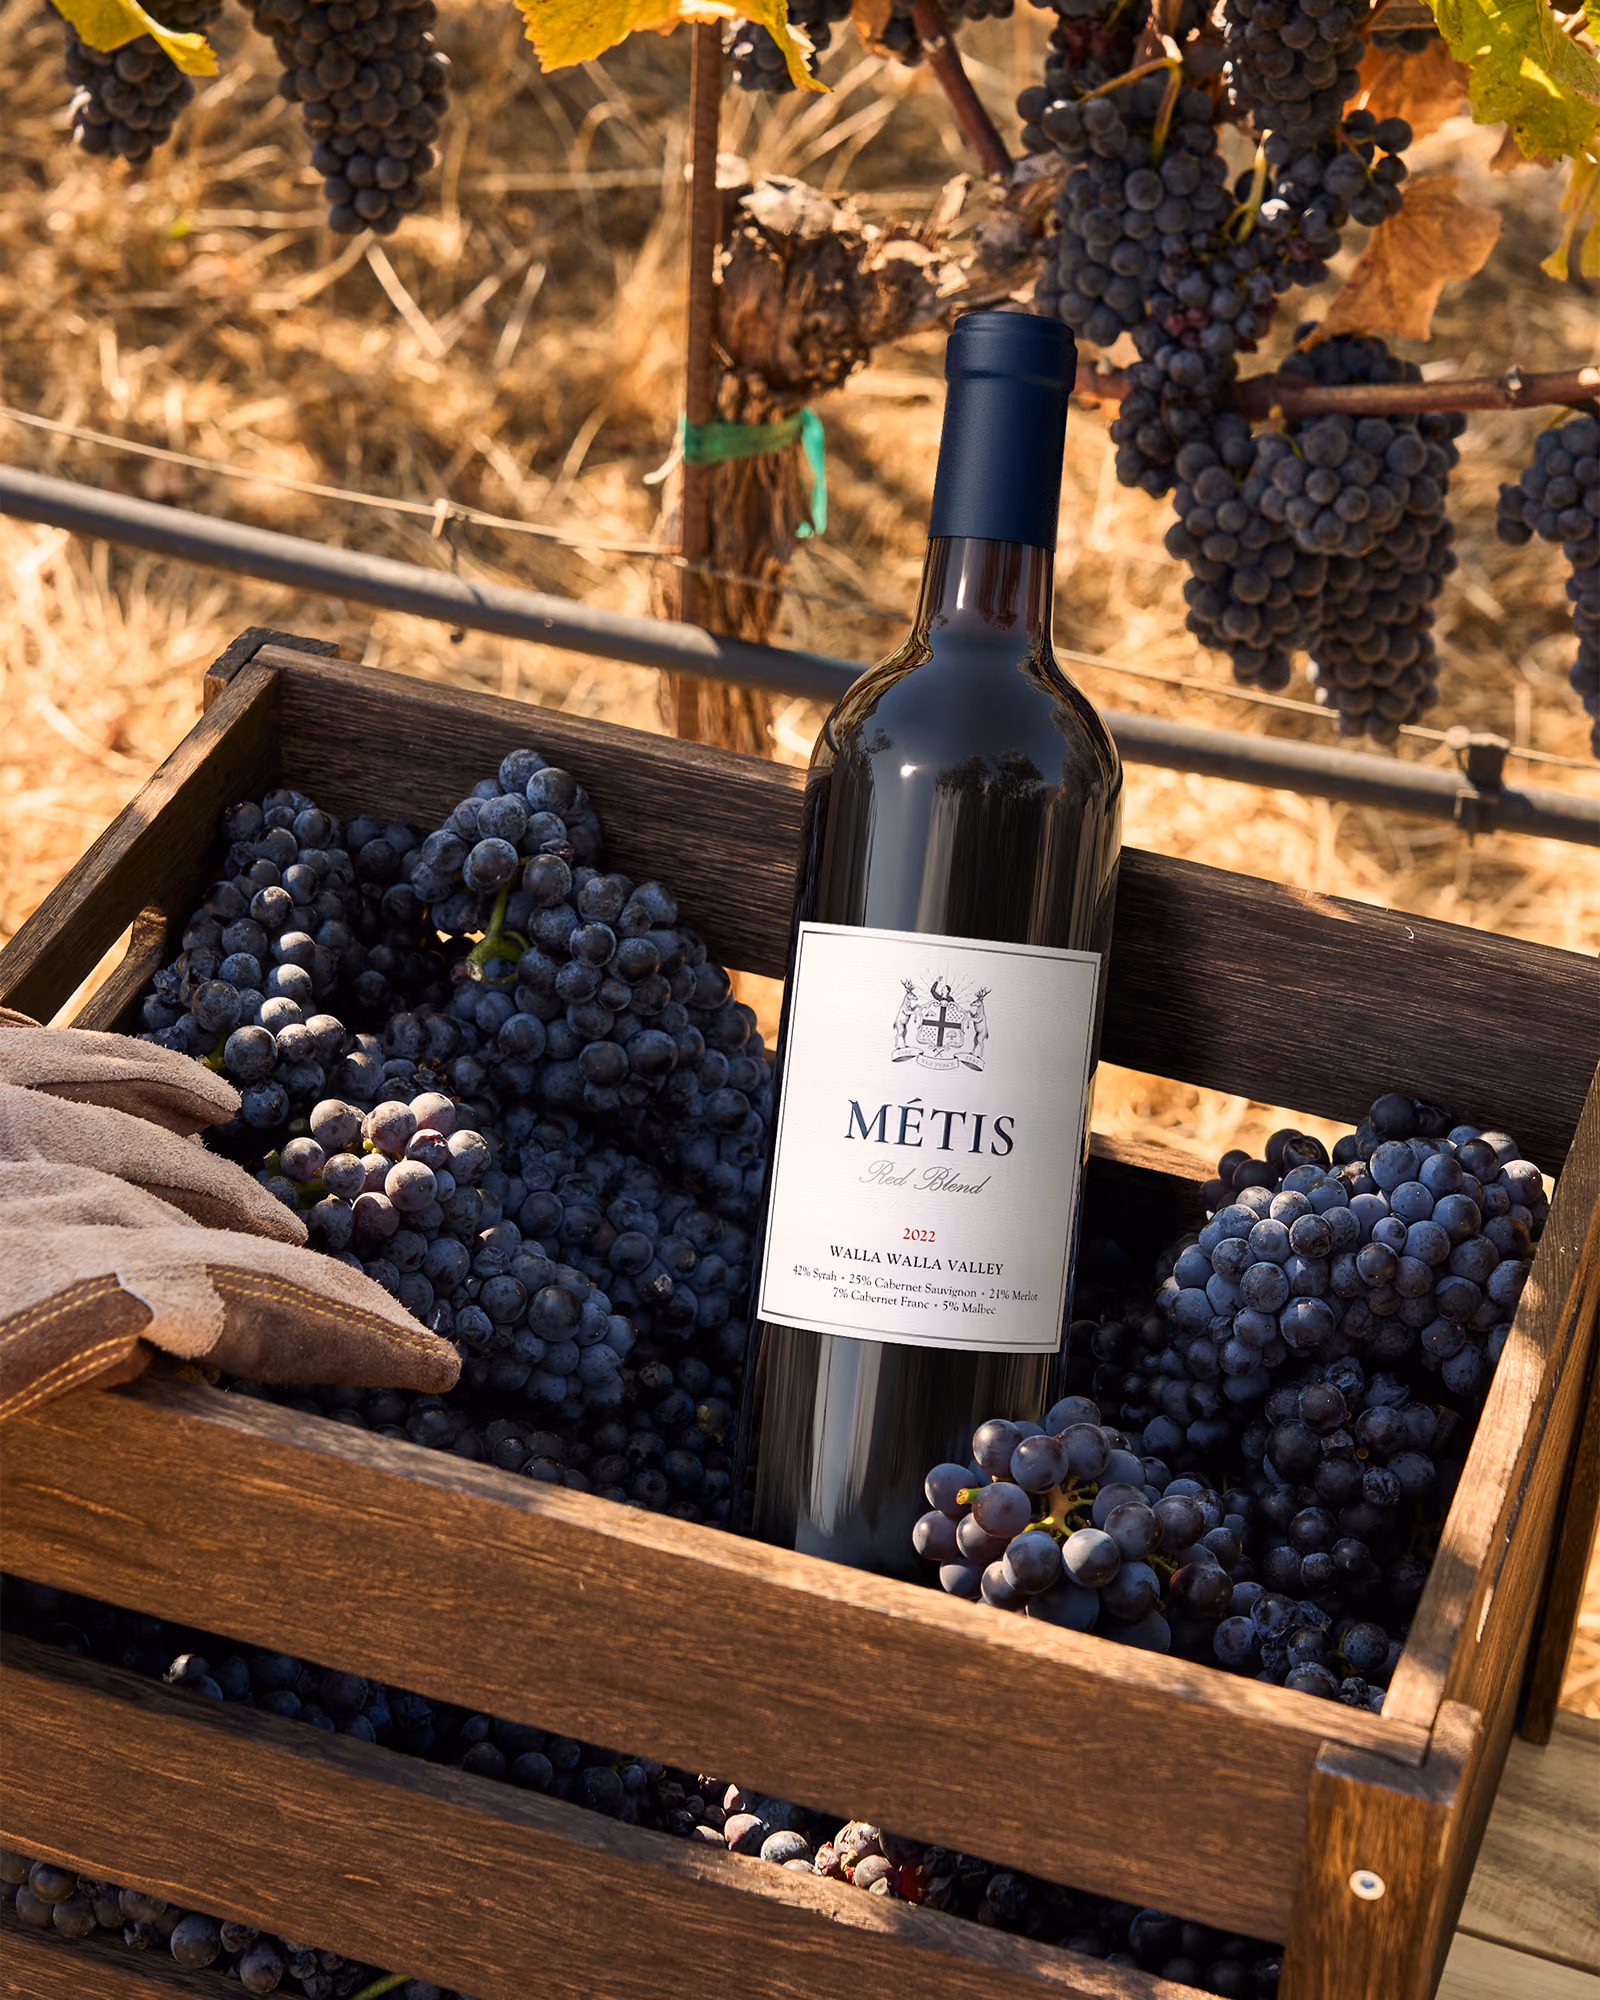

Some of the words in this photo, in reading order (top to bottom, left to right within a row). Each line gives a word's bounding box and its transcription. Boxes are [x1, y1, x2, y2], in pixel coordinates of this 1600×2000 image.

[844, 1097, 1016, 1156] MÉTIS
[859, 1160, 916, 1186] Red
[914, 1166, 992, 1195] Blend
[902, 1228, 936, 1243] 2022
[829, 1245, 882, 1263] WALLA
[887, 1253, 942, 1270] WALLA
[948, 1260, 1004, 1275] VALLEY
[793, 1265, 811, 1276] 42%
[812, 1268, 837, 1281] Syrah
[848, 1273, 872, 1286] 25%
[874, 1277, 922, 1292] Cabernet
[924, 1283, 977, 1298] Sauvignon
[989, 1288, 1010, 1300] 21%
[1011, 1290, 1038, 1302] Merlot
[832, 1287, 849, 1299] 7%
[851, 1290, 897, 1305] Cabernet
[900, 1296, 930, 1309] Franc
[942, 1300, 960, 1312] 5%
[962, 1302, 997, 1315] Malbec
